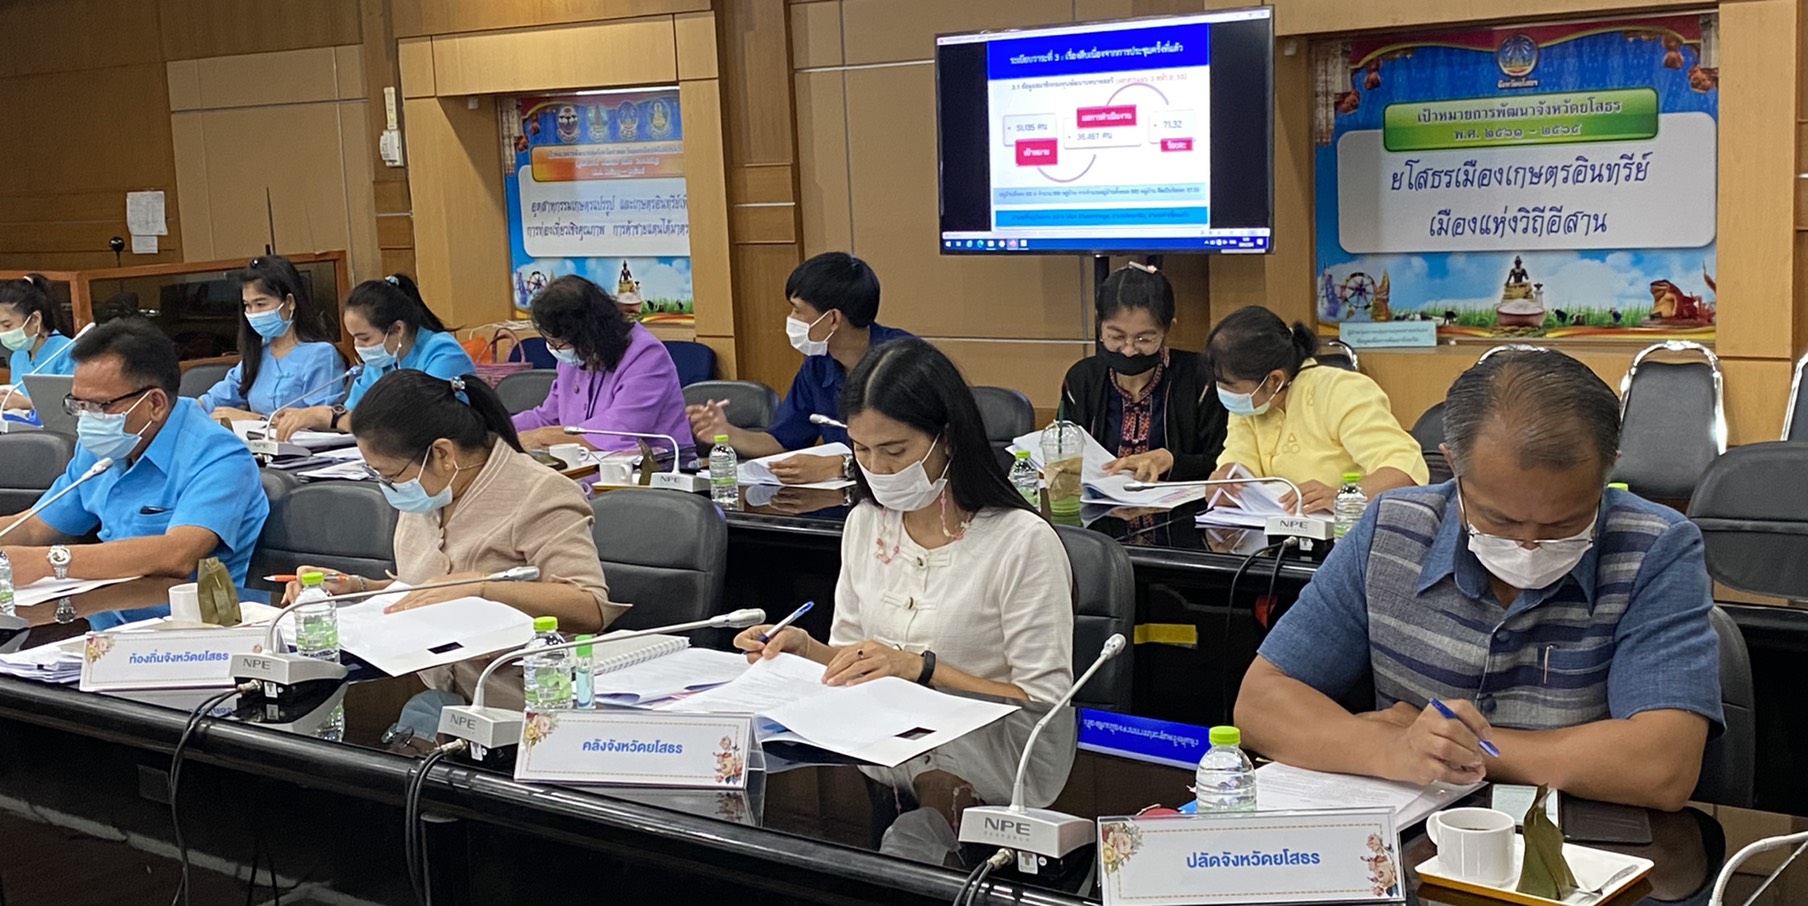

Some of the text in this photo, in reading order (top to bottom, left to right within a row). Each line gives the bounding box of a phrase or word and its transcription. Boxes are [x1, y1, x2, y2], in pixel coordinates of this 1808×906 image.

[1416, 97, 1622, 123] เป้าหมายการพัฒนาจังหวัดยโสธร
[1455, 129, 1479, 140] พ.ศ.
[1390, 151, 1653, 192] ยโสธรเมืองเกษตรอินทรีย์
[1429, 205, 1608, 239] เมืองแห่งวิถีอีสาน
[660, 475, 680, 483] NPE
[1280, 520, 1309, 529] NPE
[128, 648, 229, 665] ท้องถิ่นจังหวัดยโสธร
[243, 658, 271, 670] NPE
[450, 713, 476, 731] NPE
[582, 738, 684, 755] คลังจังหวัดยโสธร
[984, 816, 1031, 836] NPE
[1186, 848, 1321, 870] ปลัดจังหวัดยโสธร
